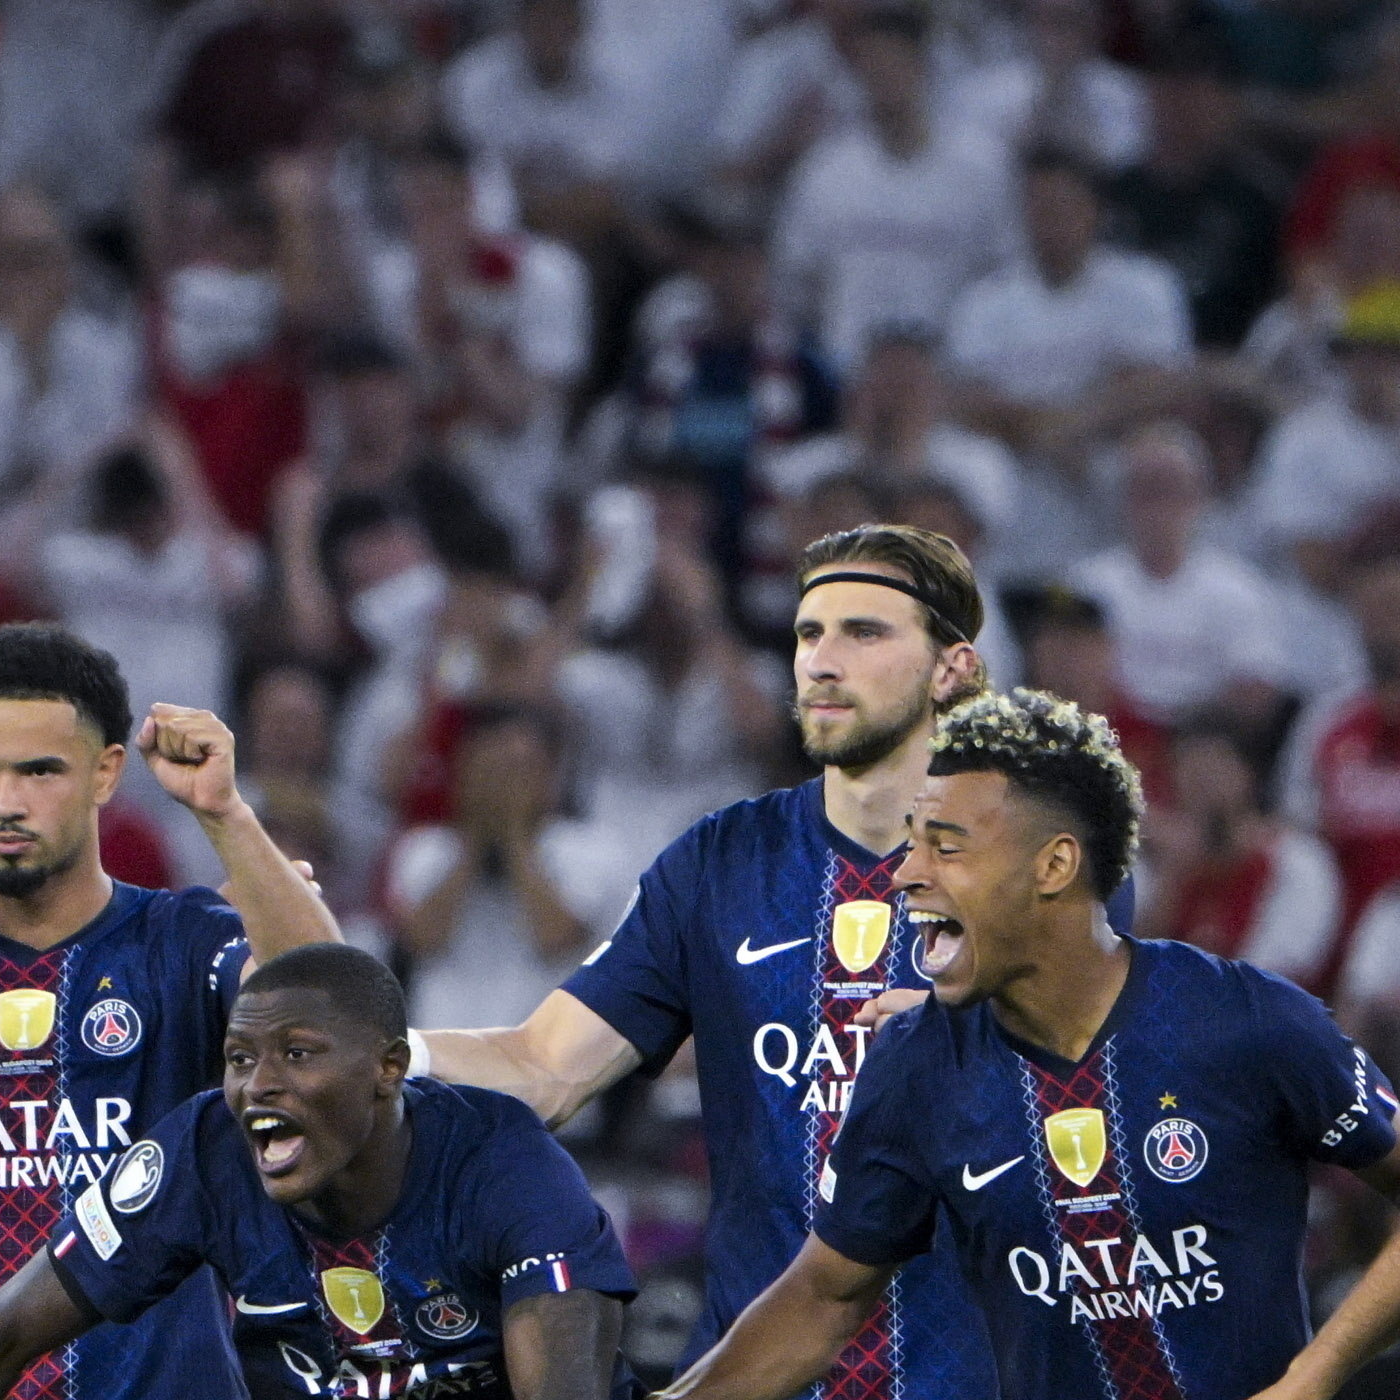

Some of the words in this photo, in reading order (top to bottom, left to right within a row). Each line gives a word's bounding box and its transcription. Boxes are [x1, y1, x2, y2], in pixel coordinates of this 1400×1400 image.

[89, 1002, 127, 1021] PARIS
[753, 1022, 872, 1088] QAT
[1322, 1047, 1369, 1147] BEYOND
[1152, 1121, 1194, 1140] PARIS
[1008, 1224, 1217, 1307] QATAR
[1069, 1270, 1225, 1325] AIRWAYS
